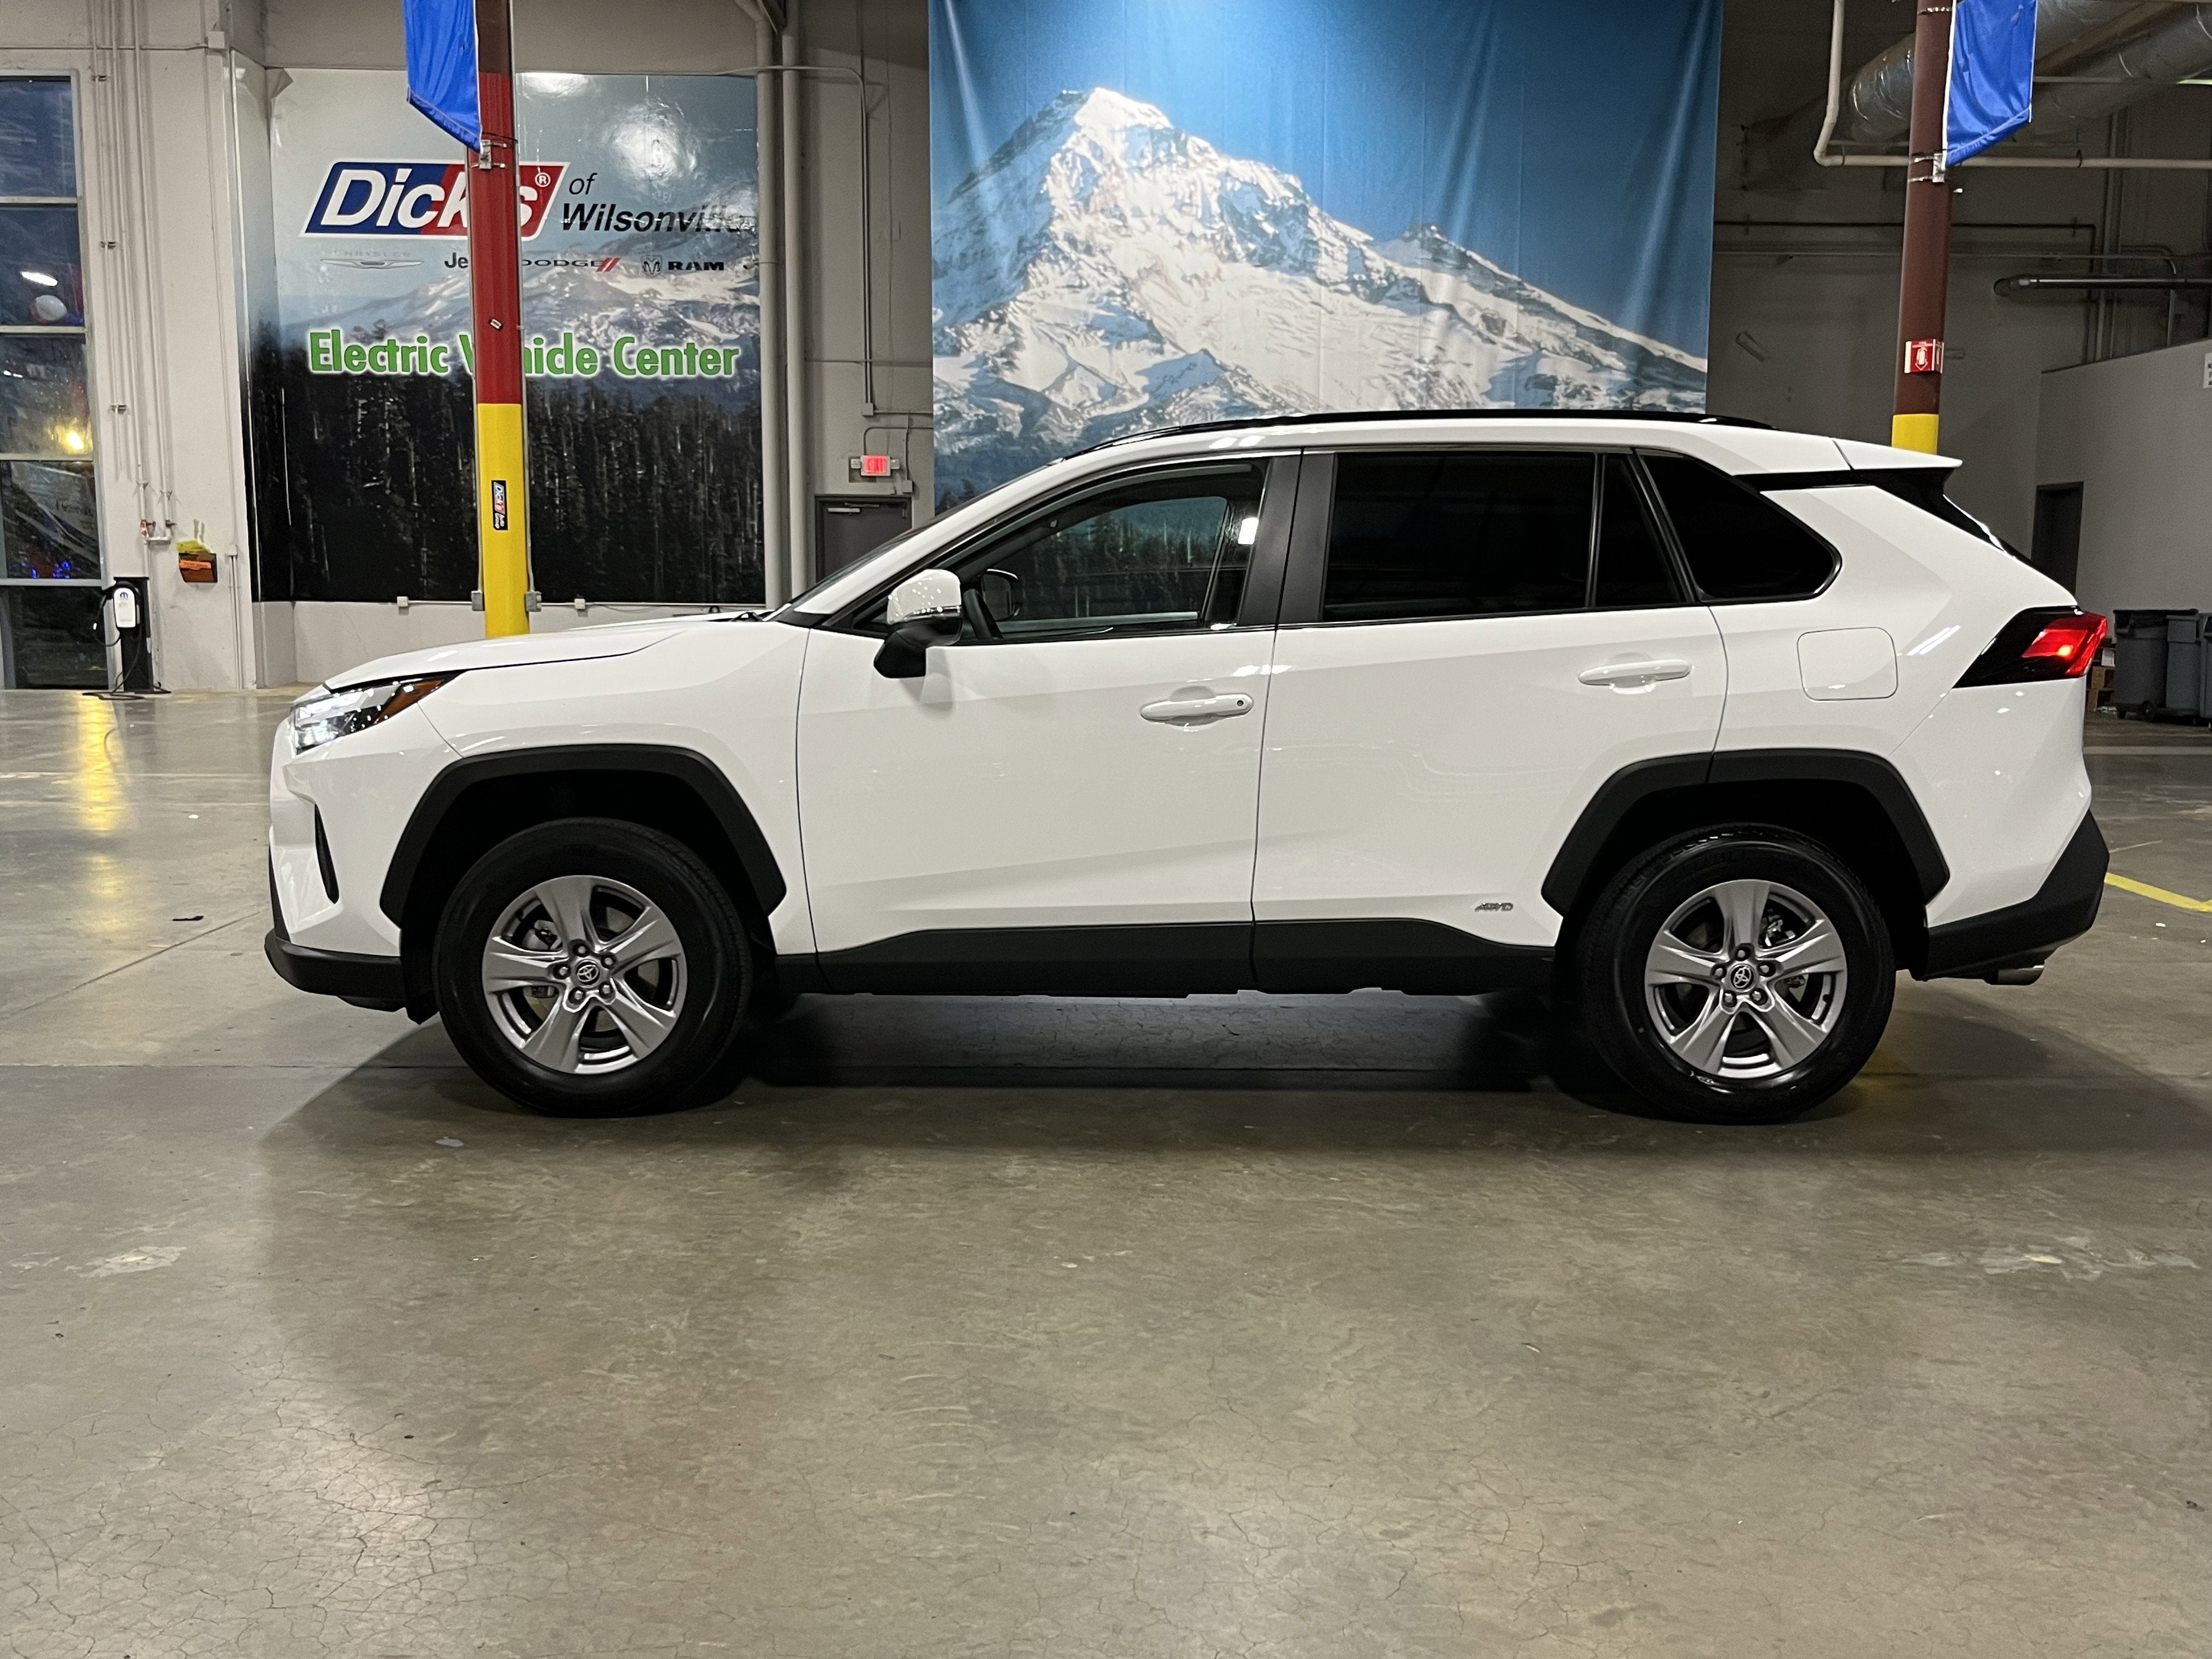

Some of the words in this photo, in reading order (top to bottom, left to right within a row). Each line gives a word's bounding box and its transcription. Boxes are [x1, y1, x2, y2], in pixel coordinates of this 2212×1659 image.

[569, 173, 598, 195] of
[320, 168, 538, 228] Dicks
[562, 203, 744, 232] Wilsonvi
[444, 252, 469, 268] Je
[668, 261, 724, 270] RAM
[310, 329, 448, 373] Electric
[459, 333, 598, 375] Vicle
[613, 336, 740, 376] Center
